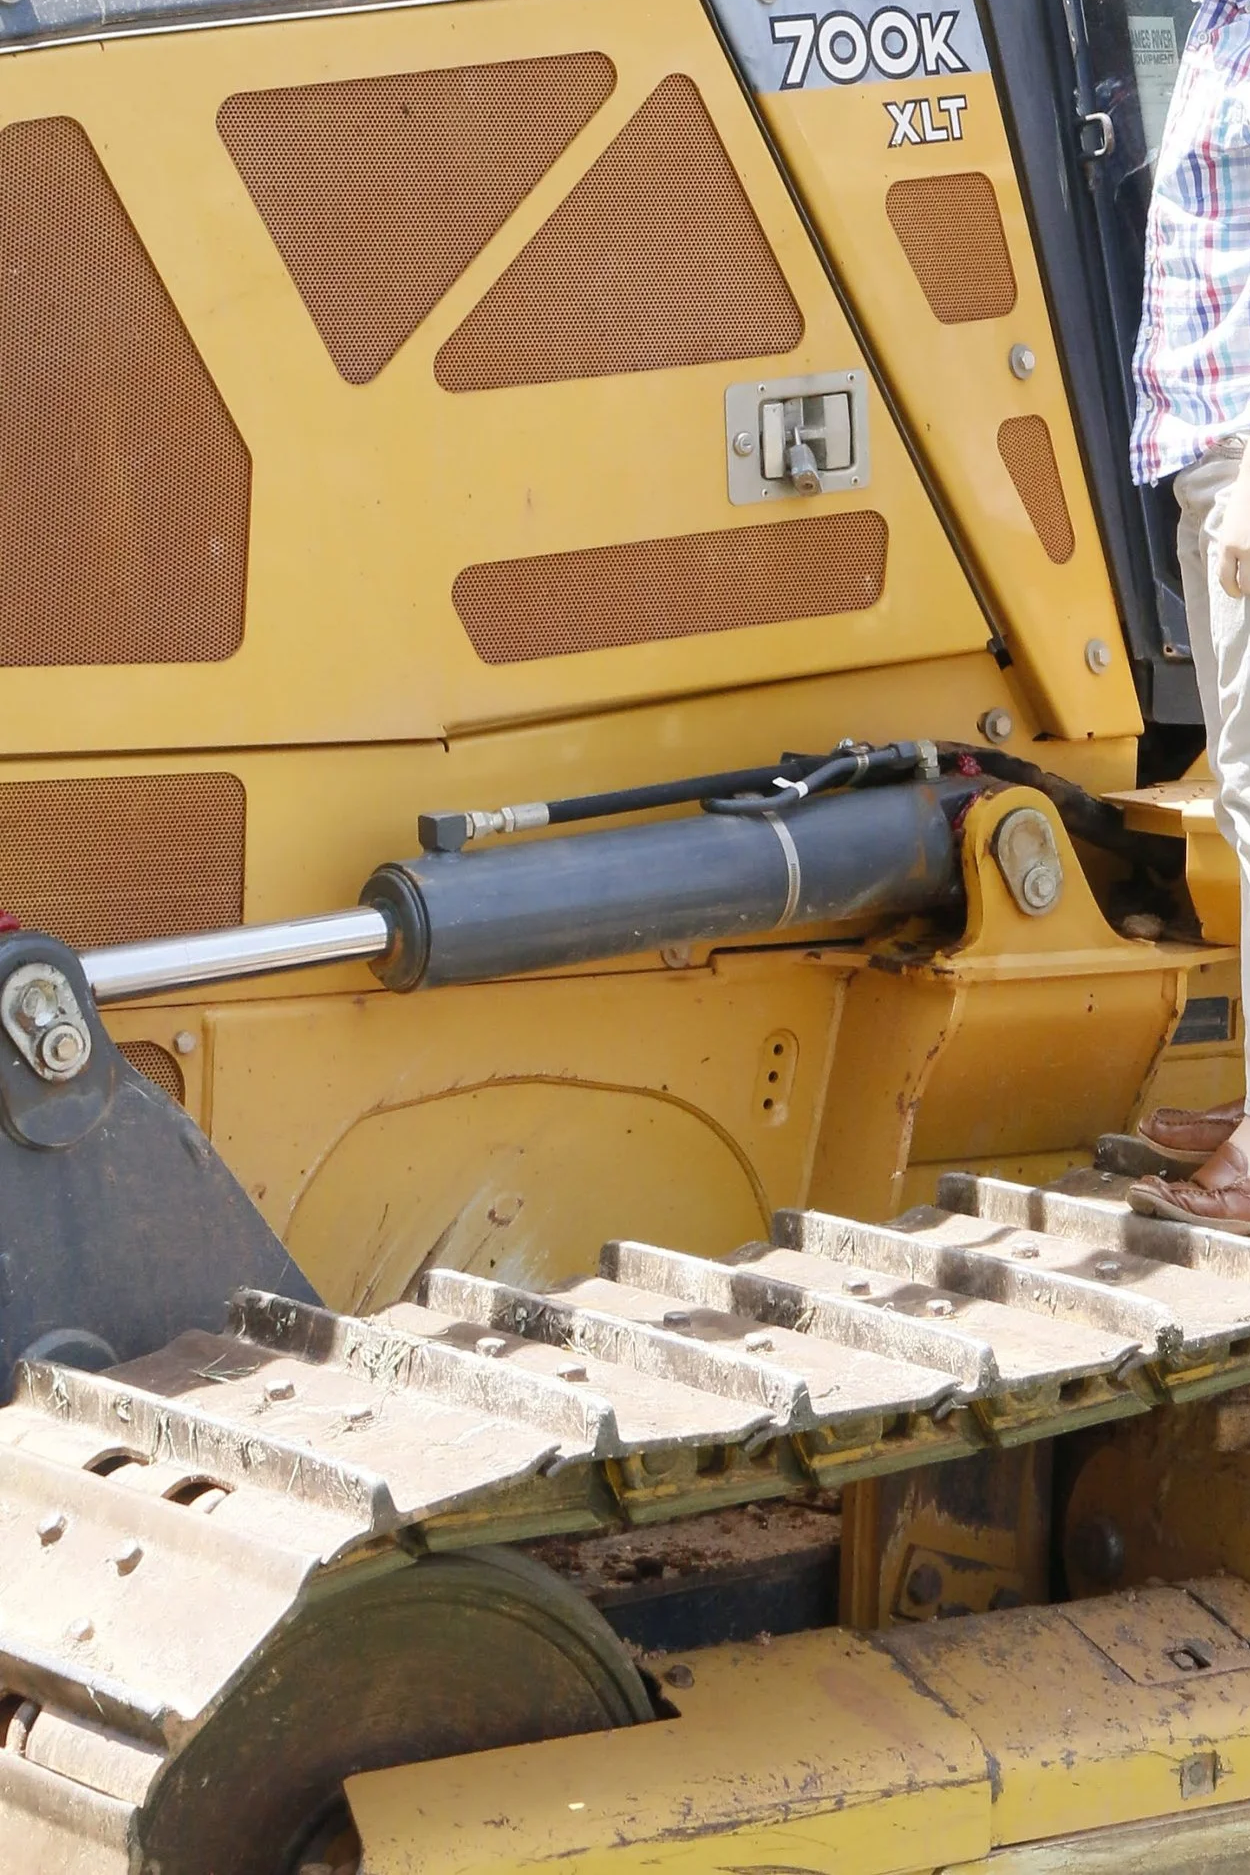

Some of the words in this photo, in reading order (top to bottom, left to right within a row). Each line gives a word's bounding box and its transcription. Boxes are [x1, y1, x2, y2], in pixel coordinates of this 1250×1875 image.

[769, 6, 971, 91] 700K
[1131, 29, 1151, 49] AMES
[1133, 53, 1174, 65] QUIPMENT
[882, 94, 967, 149] XLT
